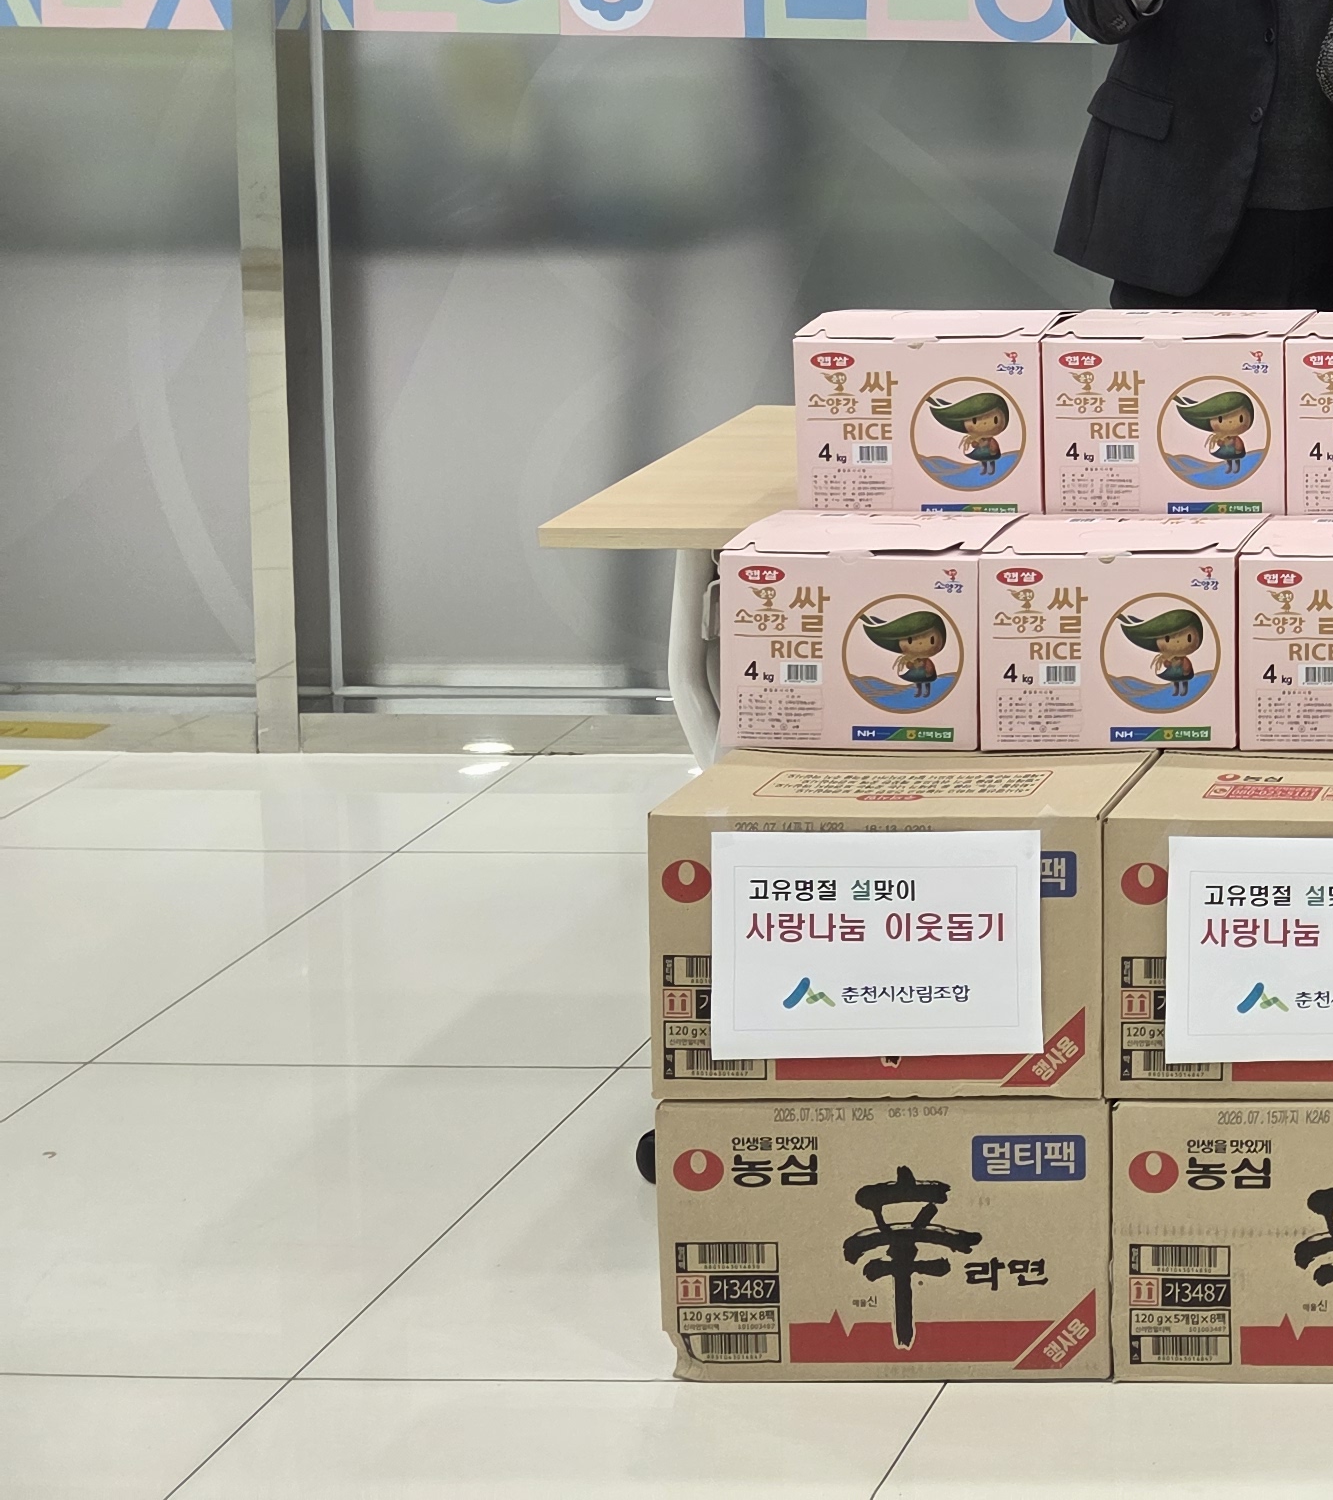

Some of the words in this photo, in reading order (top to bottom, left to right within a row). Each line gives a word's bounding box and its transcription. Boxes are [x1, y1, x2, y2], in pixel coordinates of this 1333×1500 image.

[808, 394, 858, 414] 소양강
[859, 371, 898, 415] 쌀
[843, 423, 892, 441] RICE
[818, 443, 832, 462] 4
[836, 453, 847, 463] kg
[1047, 586, 1088, 634] 쌀
[993, 612, 1047, 633] 소양강
[1030, 642, 1082, 660] RICE
[1003, 663, 1018, 683] 4
[1022, 673, 1033, 684] kg
[748, 879, 837, 901] 고유명절
[851, 878, 916, 902] 설맞이
[1203, 884, 1292, 907] 고유명절
[745, 912, 866, 943] 사랑나눔
[885, 912, 1005, 943] 이웃돕기
[1200, 918, 1320, 949] 사랑나눔
[840, 984, 970, 1004] 춘천시산림조합
[731, 1136, 773, 1151] 인생을
[775, 1136, 819, 1151] 맛있게
[731, 1153, 819, 1187] 농심
[981, 1142, 1076, 1175] 멀티팩
[1186, 1157, 1272, 1190] 농심
[843, 1166, 983, 1349] 辛
[964, 1257, 1049, 1290] 라면
[713, 1278, 776, 1299] 가3487
[682, 1310, 702, 1322] 120
[1043, 1317, 1091, 1364] 행사용
